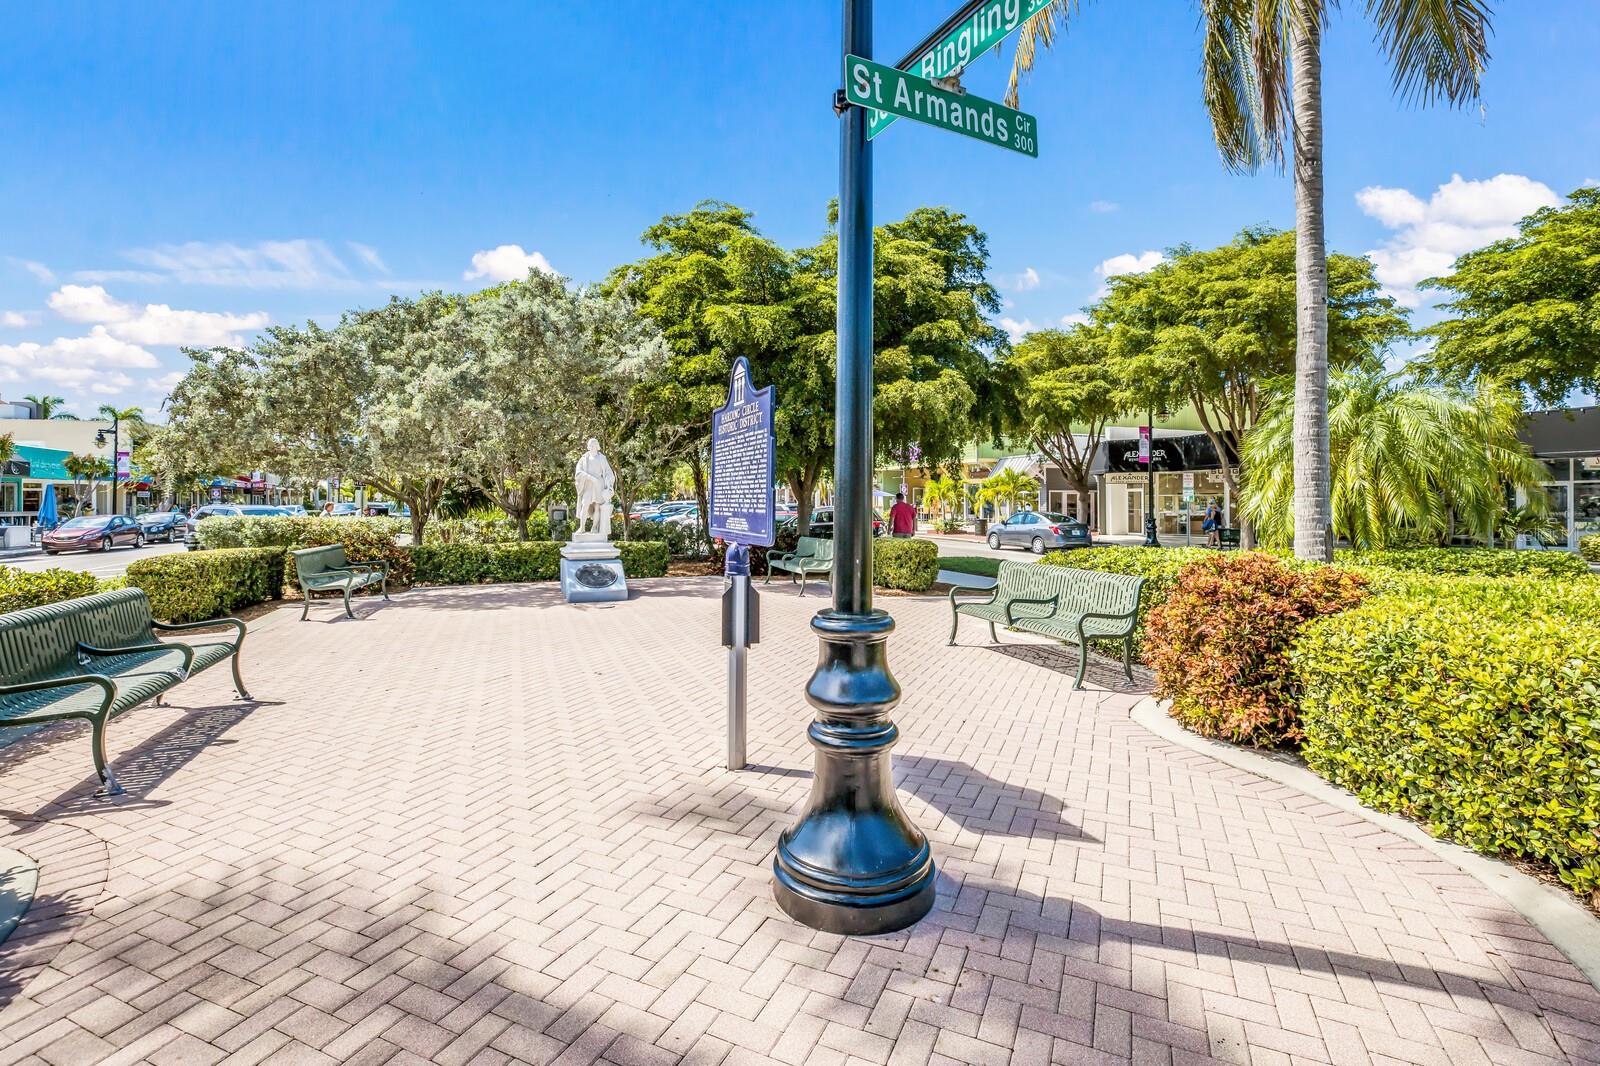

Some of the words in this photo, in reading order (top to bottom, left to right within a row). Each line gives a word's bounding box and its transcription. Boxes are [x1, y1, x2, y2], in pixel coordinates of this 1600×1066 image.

[921, 0, 1020, 79] Ringling
[853, 63, 883, 104] St
[893, 77, 1009, 142] Armands
[1015, 115, 1031, 133] Cir
[1014, 133, 1034, 153] 300
[742, 401, 759, 416] CIRCLE
[739, 411, 763, 429] DISTRICT
